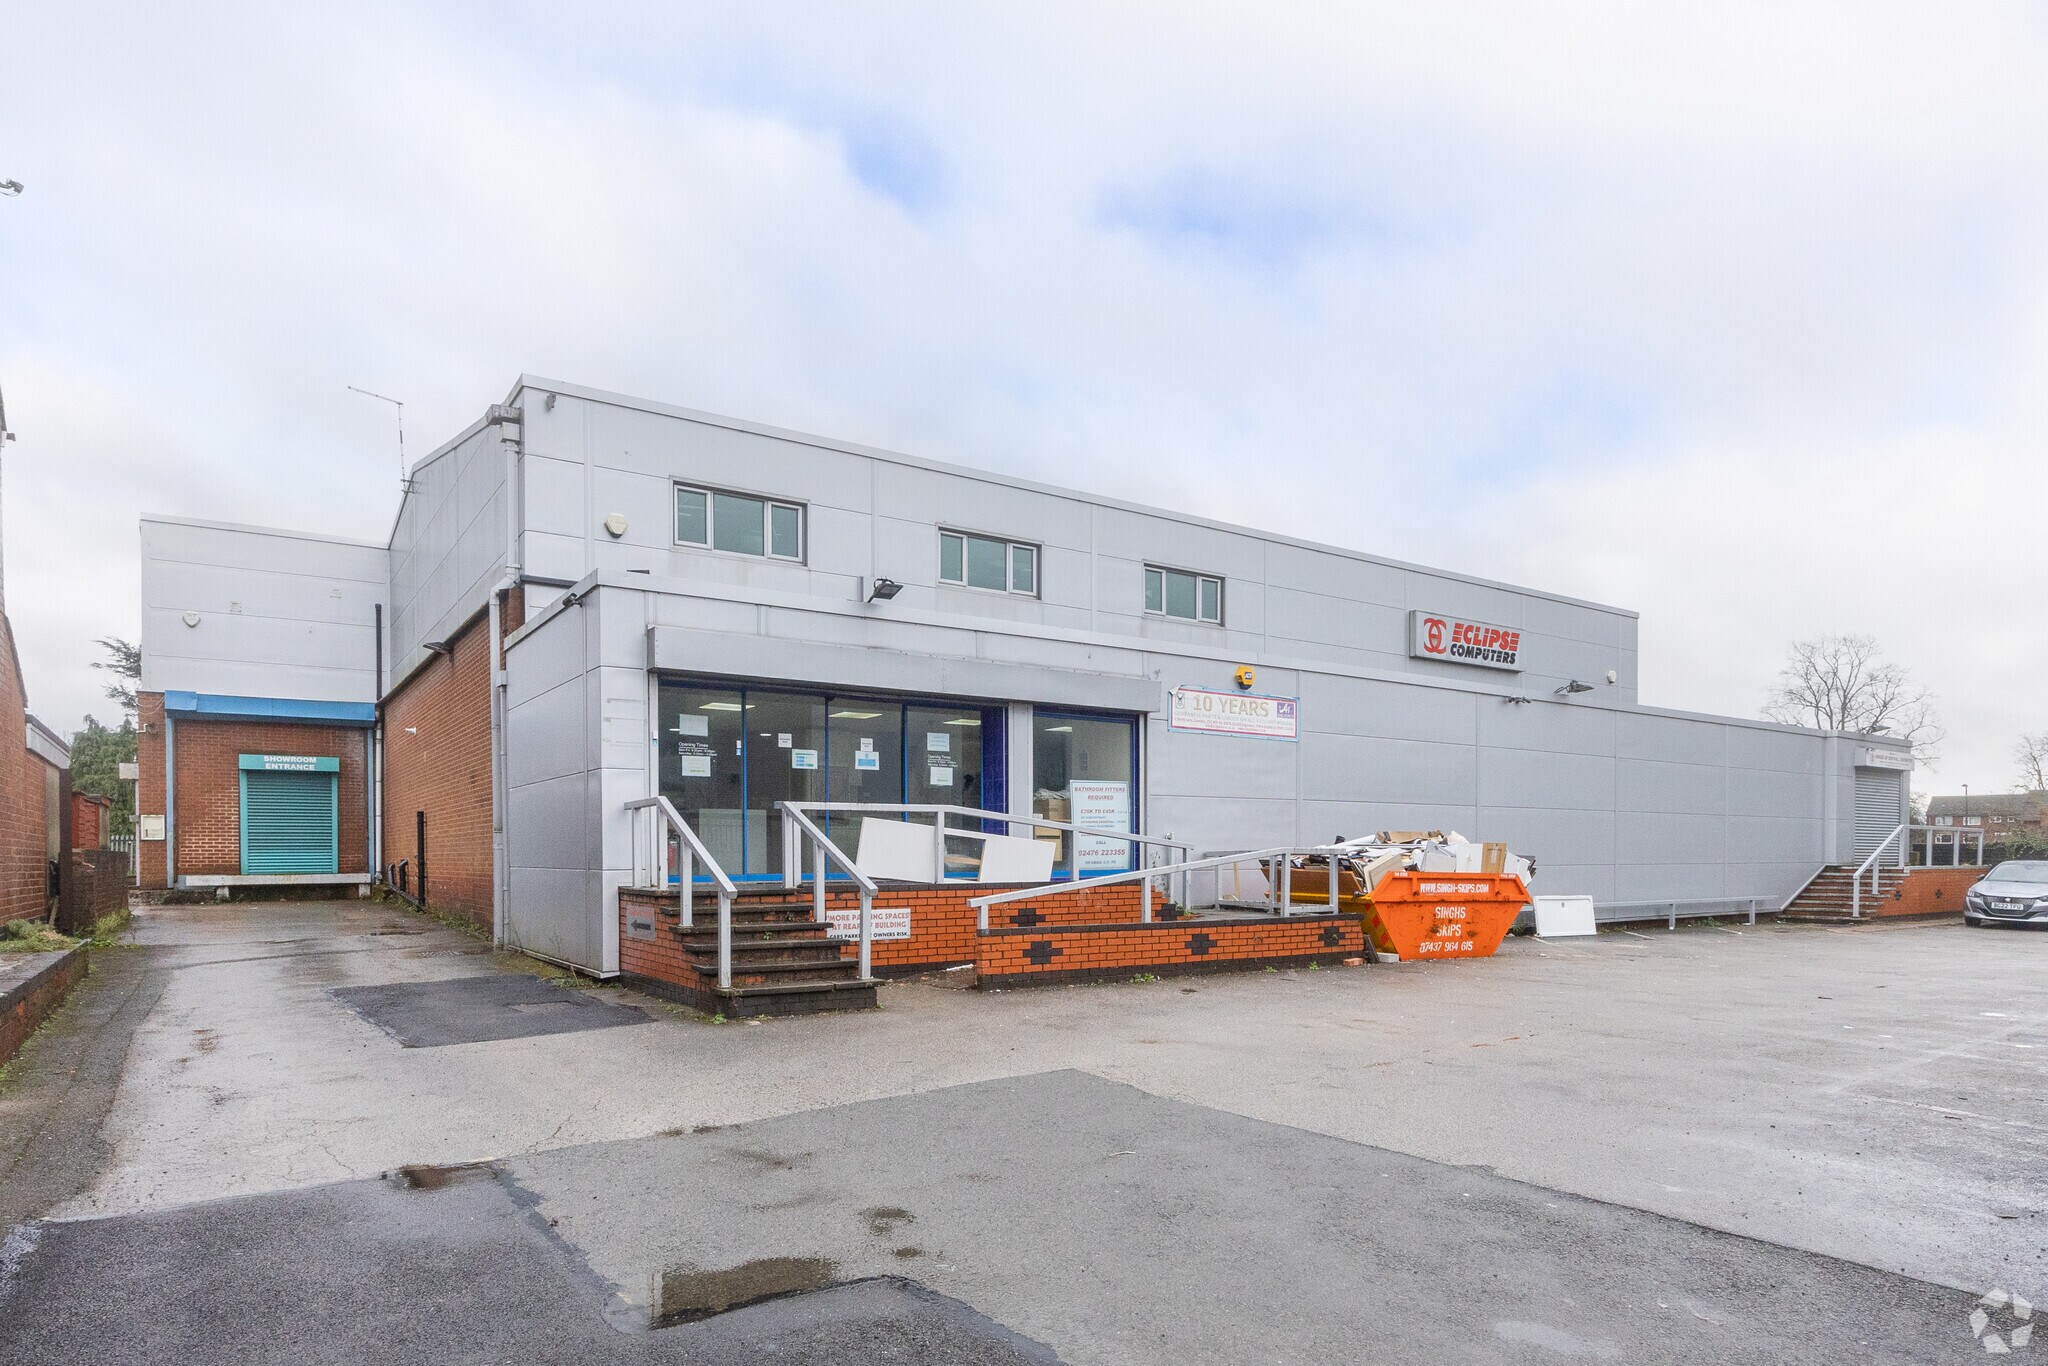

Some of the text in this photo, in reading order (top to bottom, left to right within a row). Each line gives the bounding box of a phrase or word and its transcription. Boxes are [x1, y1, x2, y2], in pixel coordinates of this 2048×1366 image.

[1452, 622, 1520, 652] ECLIPSE
[1450, 643, 1517, 665] COMPUTERS
[1193, 694, 1270, 718] 10 YEARS
[263, 755, 317, 764] SHOWROOM
[265, 762, 316, 771] ENTRANCE
[1419, 883, 1489, 894] WWW.SINGH-SKIPS.COM
[851, 913, 884, 922] PAING
[1435, 906, 1466, 919] SINGHS
[832, 923, 842, 931] AT
[874, 921, 907, 929] BUILDING
[1419, 941, 1443, 954] 07437
[1460, 941, 1474, 951] 615
